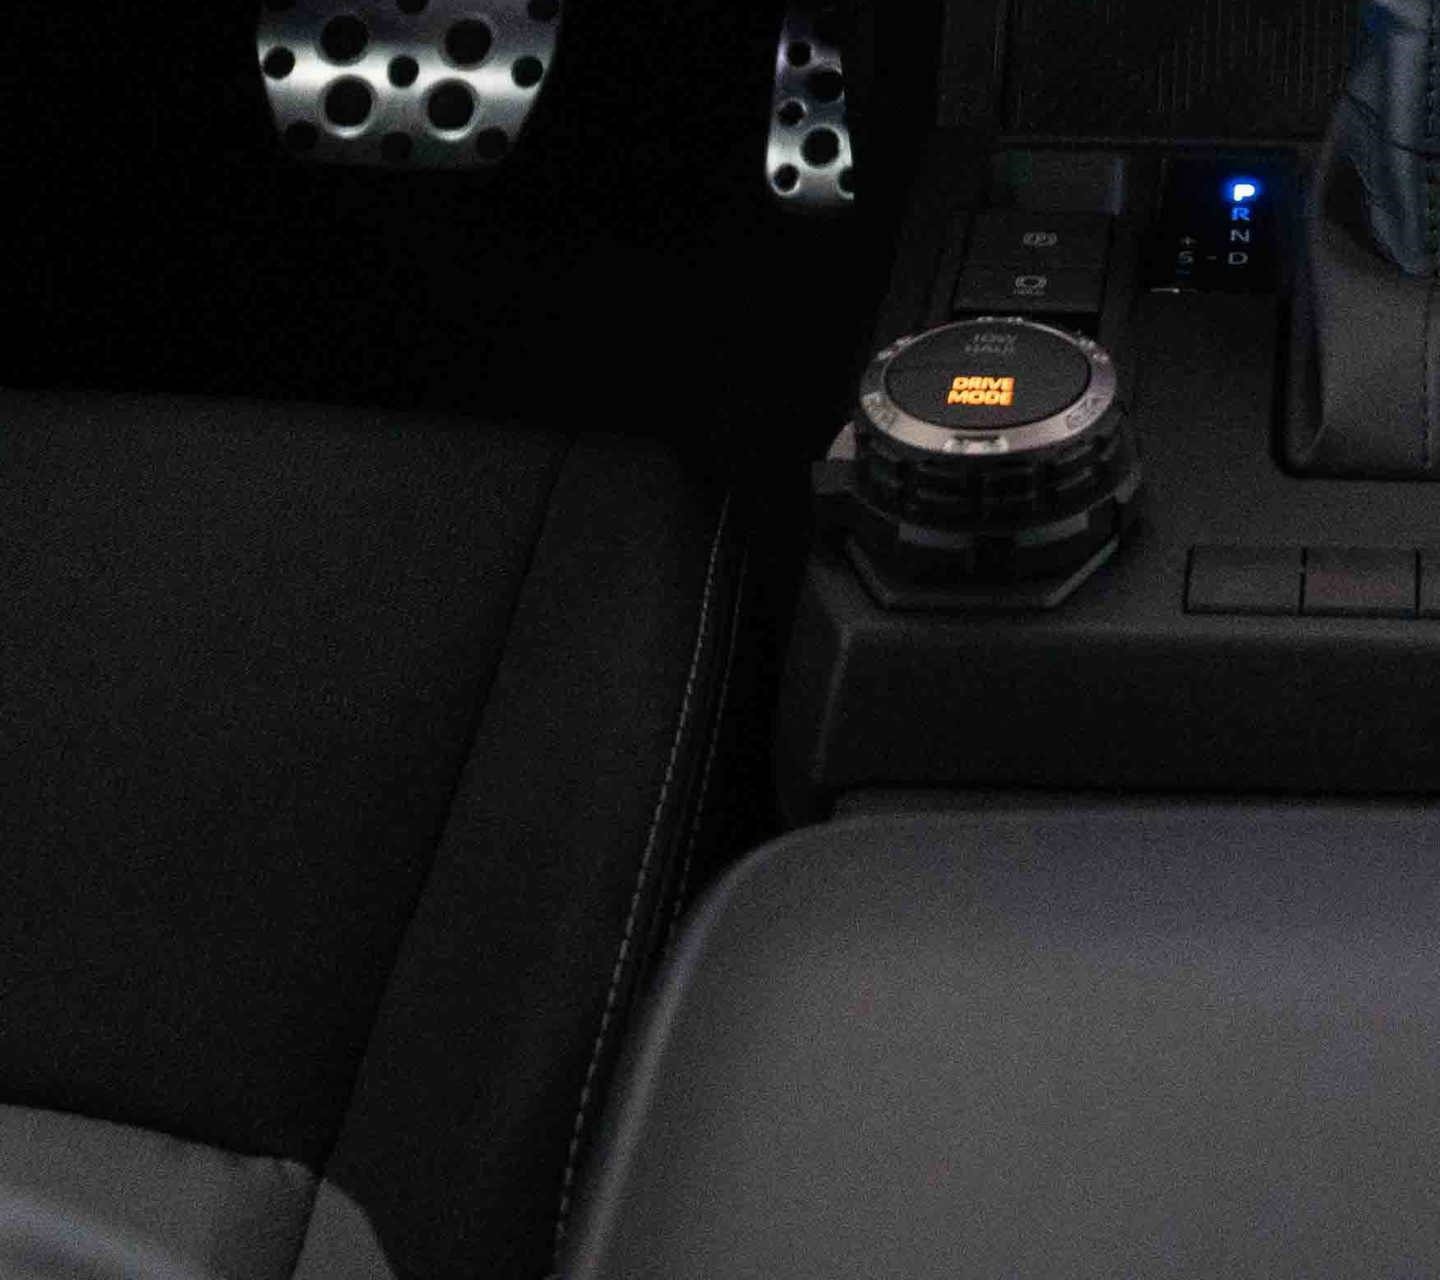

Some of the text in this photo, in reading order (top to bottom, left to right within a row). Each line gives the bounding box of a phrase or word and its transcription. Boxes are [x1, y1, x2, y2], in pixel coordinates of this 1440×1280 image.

[1232, 183, 1256, 202] P
[1231, 207, 1250, 222] R
[1229, 228, 1251, 243] N
[1227, 251, 1249, 265] D
[951, 376, 1016, 391] DRIVE
[946, 390, 1014, 406] MODE
